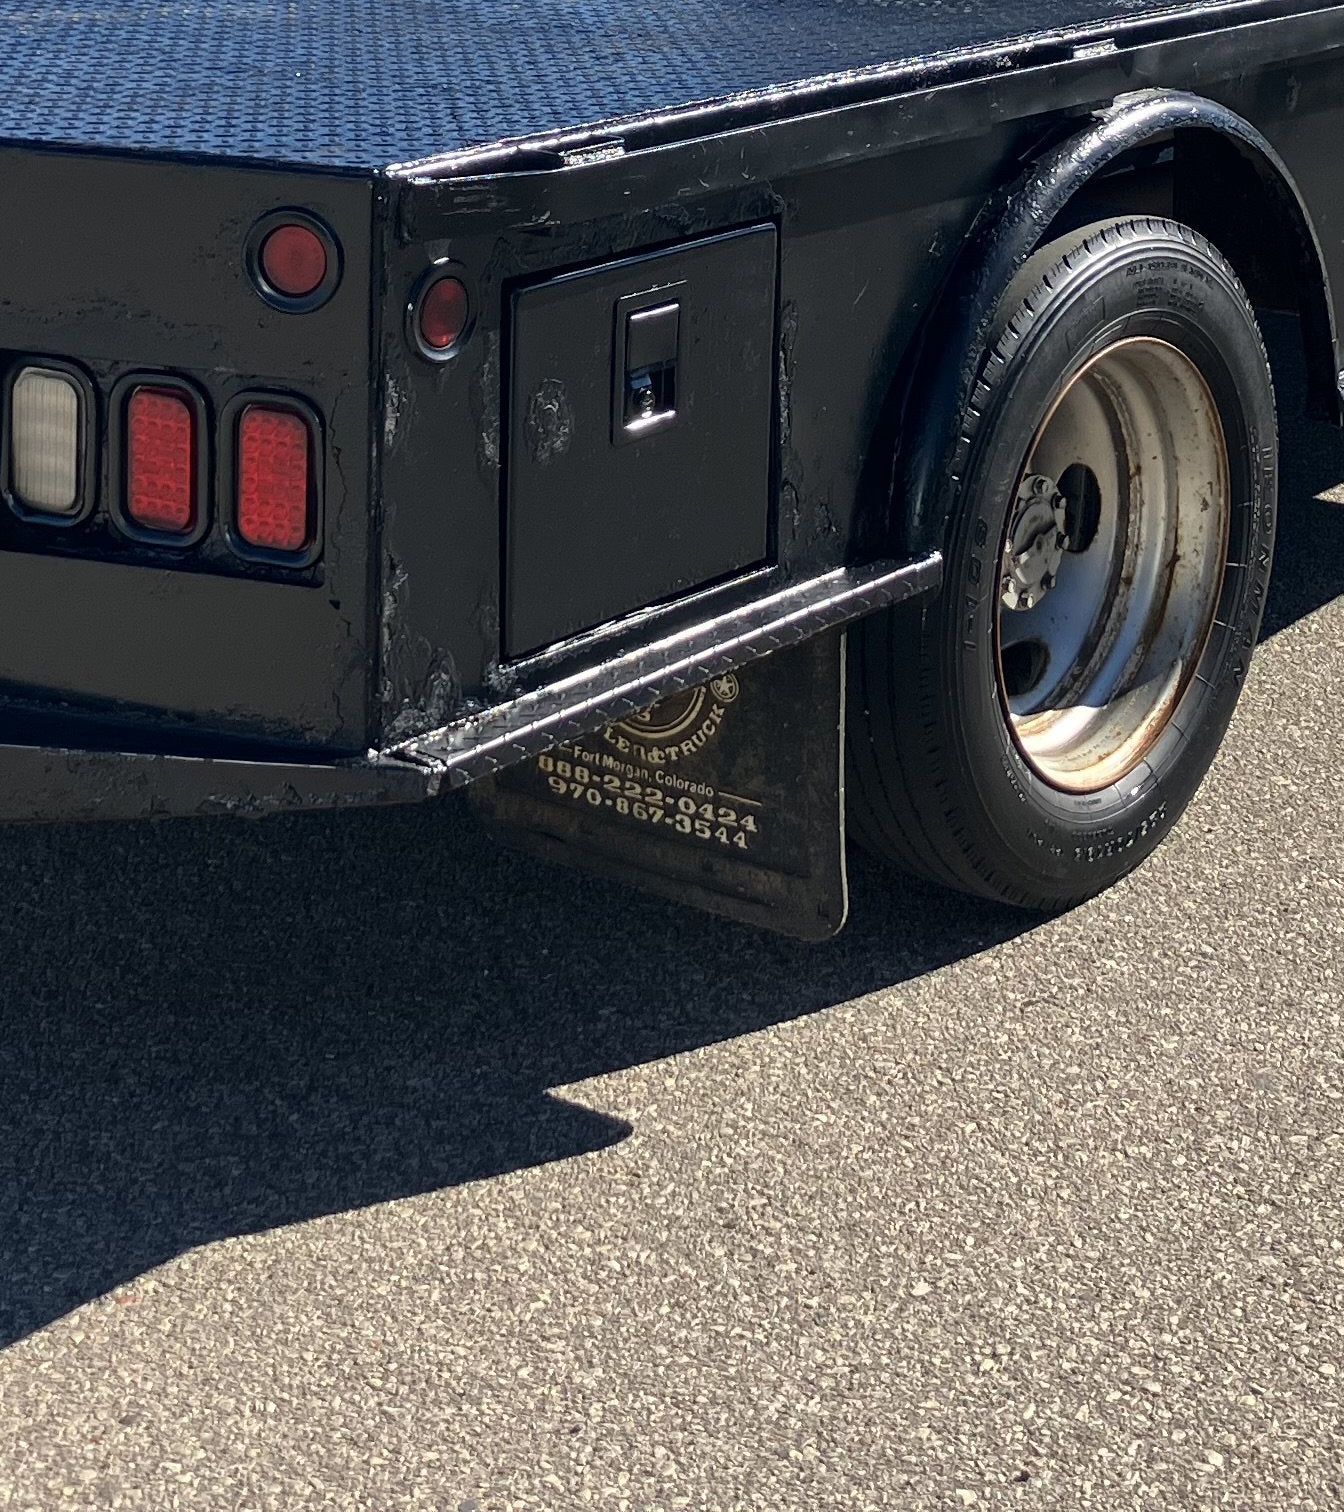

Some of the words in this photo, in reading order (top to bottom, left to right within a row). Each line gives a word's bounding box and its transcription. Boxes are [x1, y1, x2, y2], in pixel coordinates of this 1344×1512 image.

[538, 754, 758, 833] 888-222-0424
[573, 745, 601, 766] Fort
[655, 770, 714, 797] Colorado
[547, 775, 749, 850] 970-867-3544
